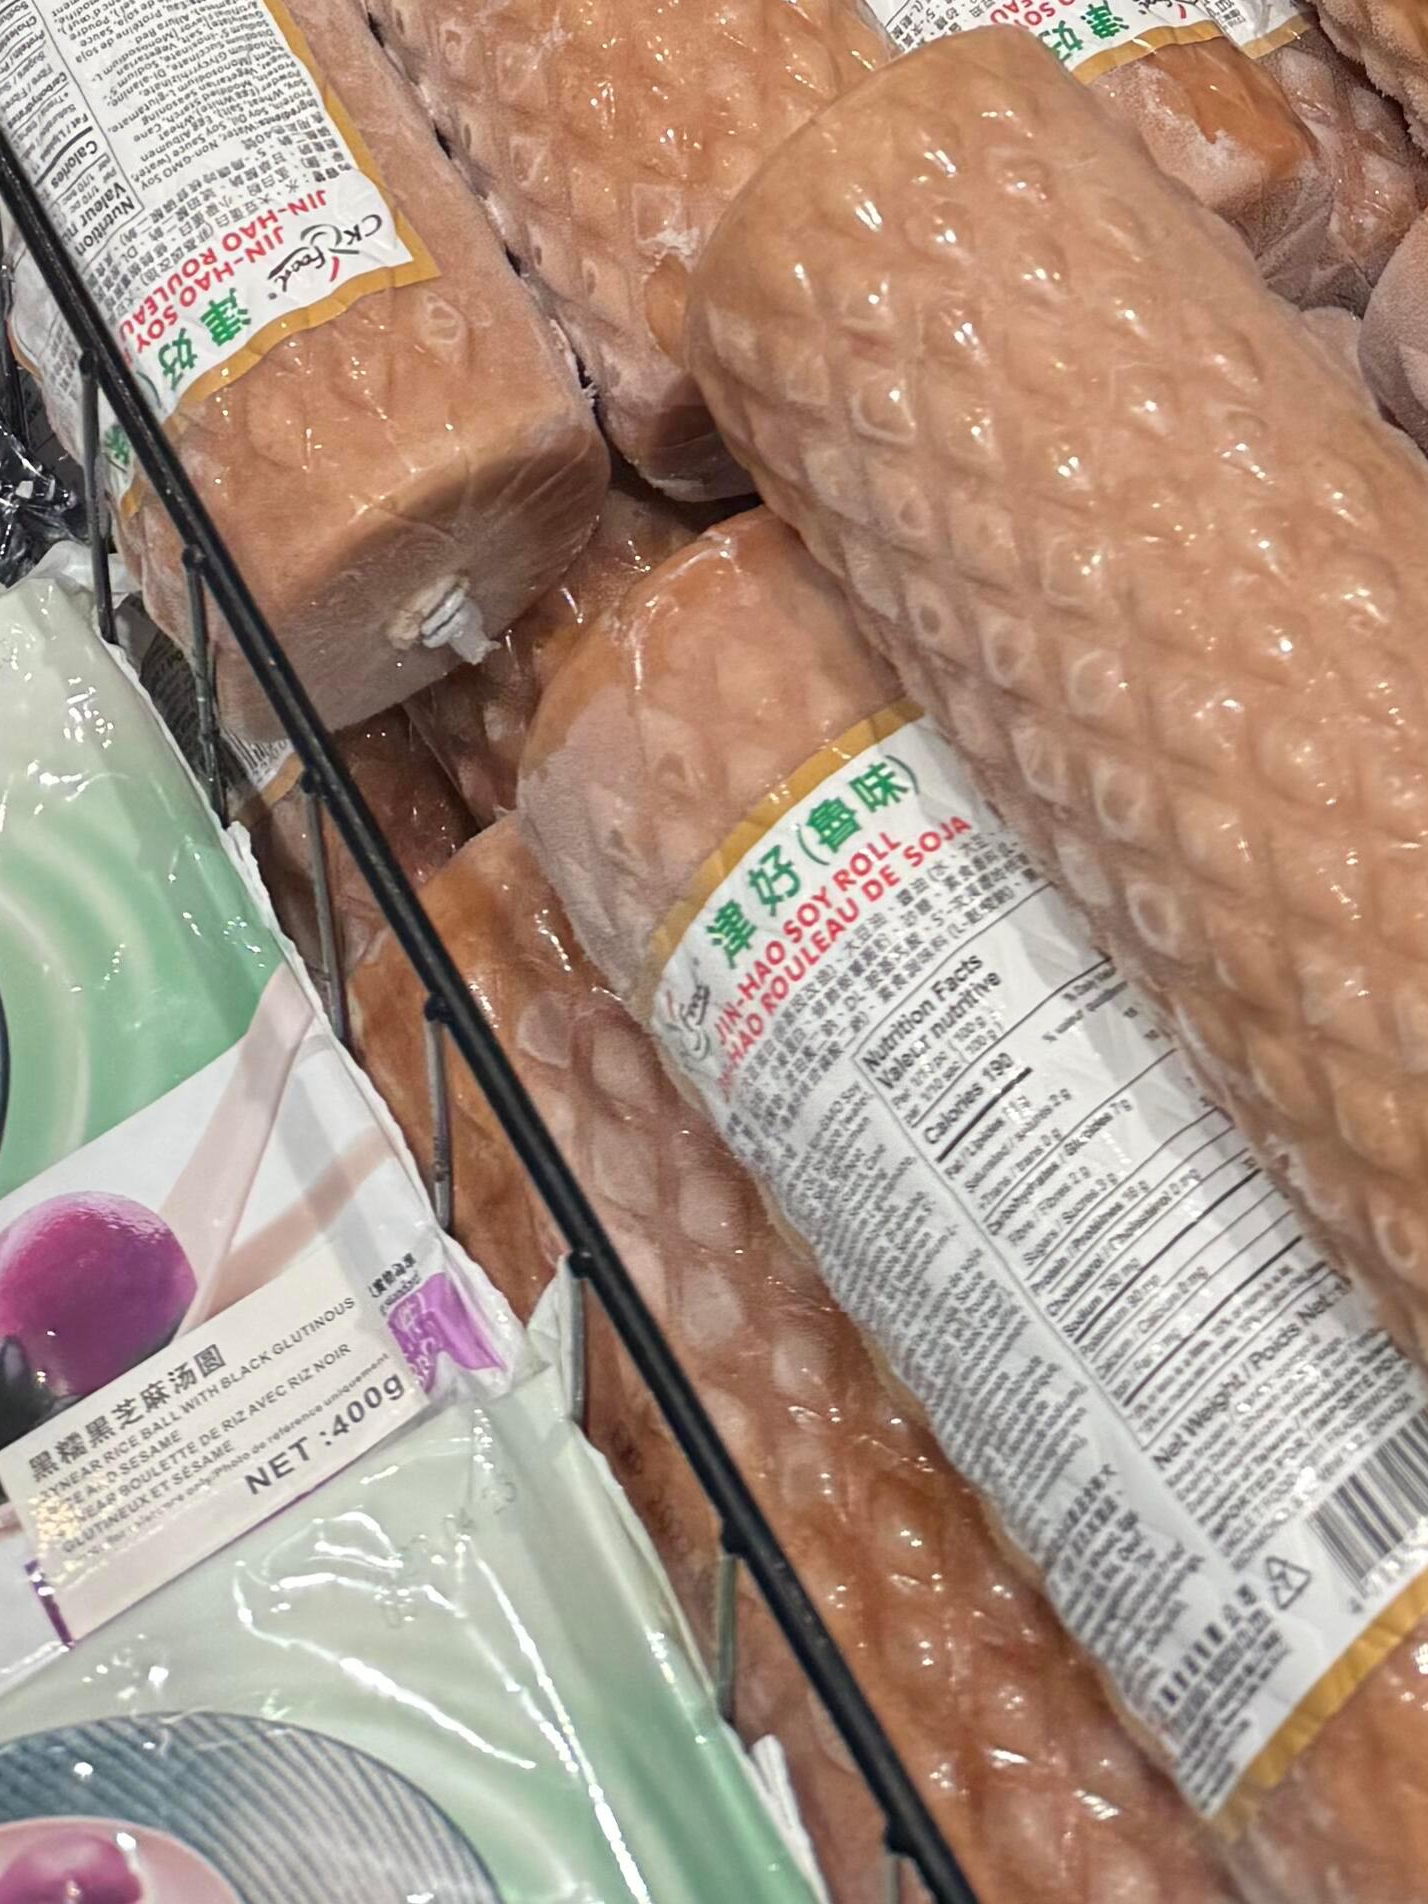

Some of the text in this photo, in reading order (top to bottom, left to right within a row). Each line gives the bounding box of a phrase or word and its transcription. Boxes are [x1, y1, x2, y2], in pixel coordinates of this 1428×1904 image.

[114, 186, 329, 342] JIN-HAO ROULEAU
[130, 224, 289, 354] JIN-HAO SOY
[271, 211, 385, 295] CK Food
[698, 747, 924, 969] 津好(魯味)
[757, 811, 972, 1014] ROULEAU DE SOJA
[711, 826, 901, 1045] JIN-HAO SOY ROLL
[859, 951, 984, 1075] Nutrition Facts
[243, 1371, 408, 1495] NET :400g
